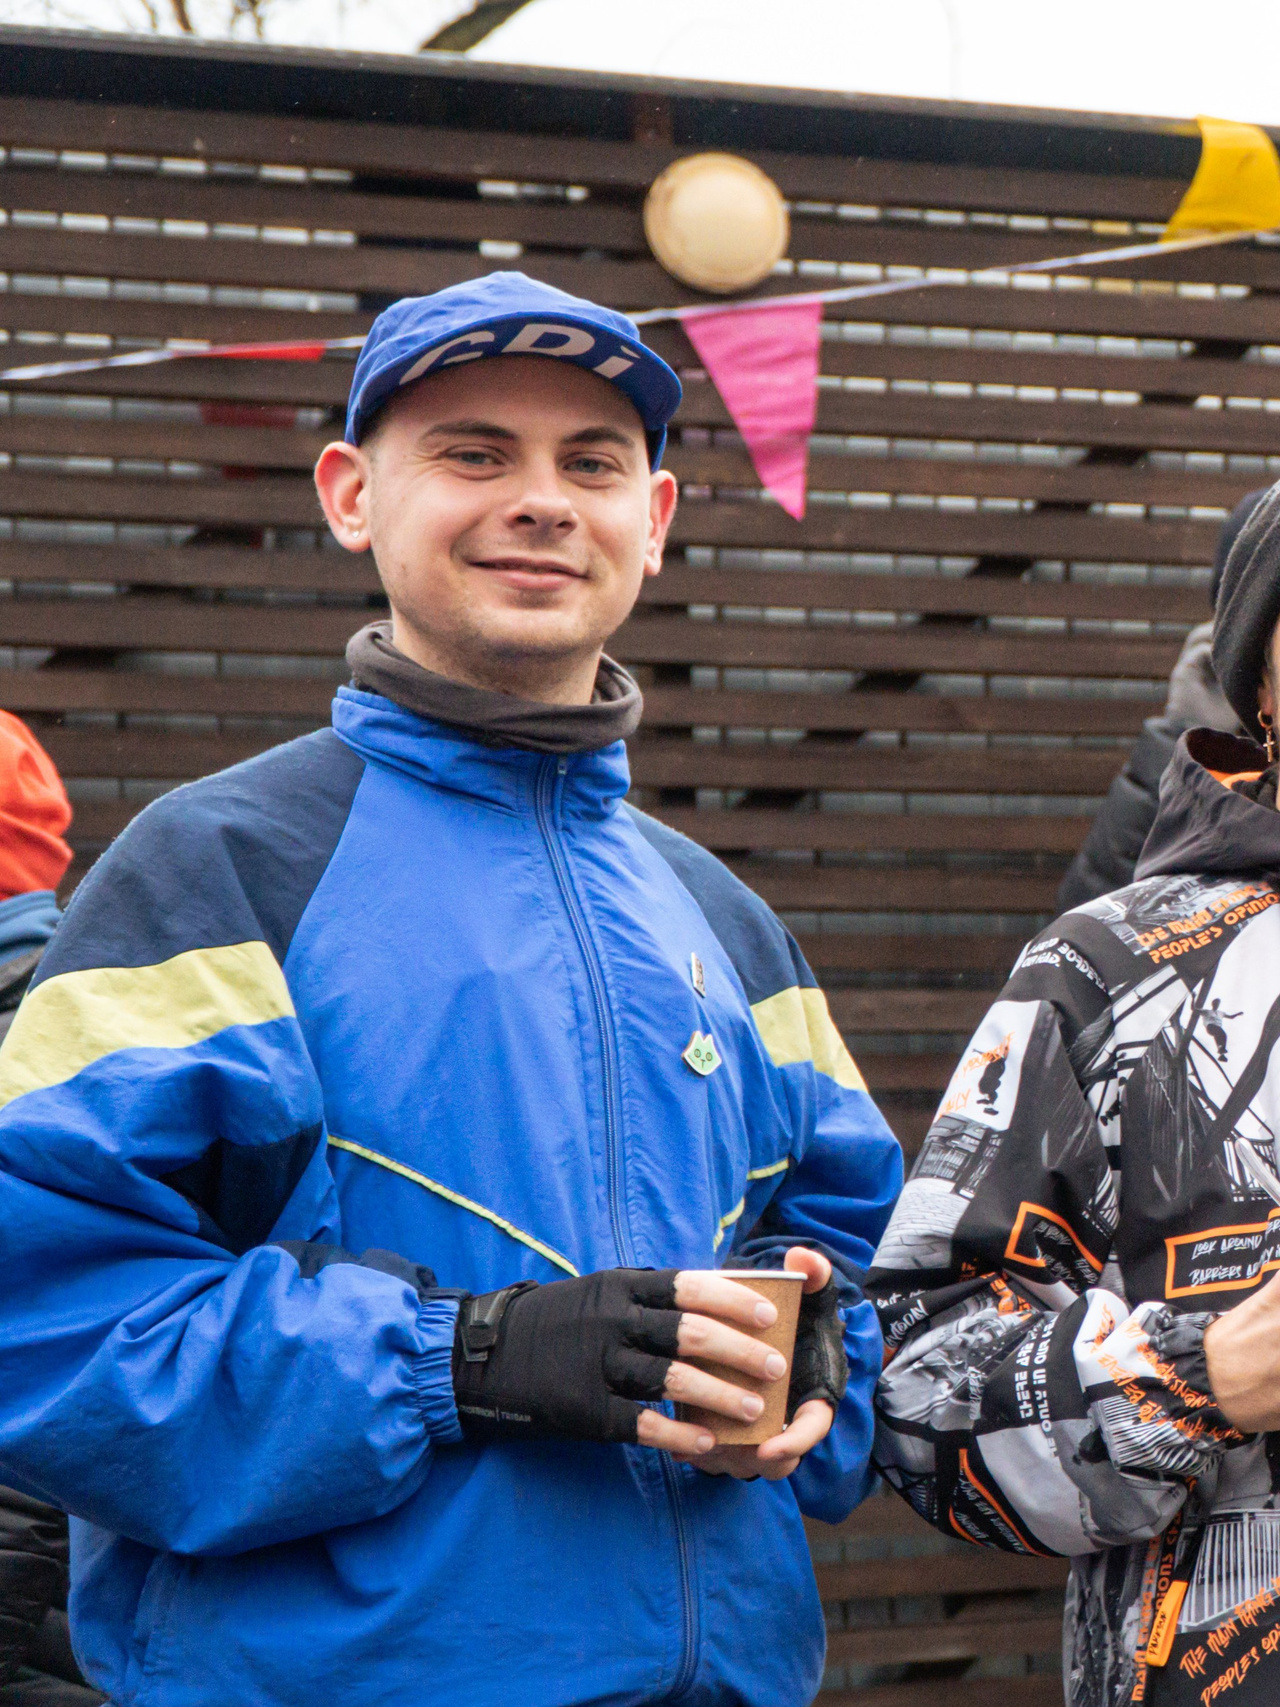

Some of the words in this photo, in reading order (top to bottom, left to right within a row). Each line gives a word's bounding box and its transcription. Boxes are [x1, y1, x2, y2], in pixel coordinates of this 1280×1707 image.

[1188, 1265, 1243, 1288] BARRIERS
[1179, 1645, 1208, 1679] THE
[1207, 1621, 1240, 1657] MAIN
